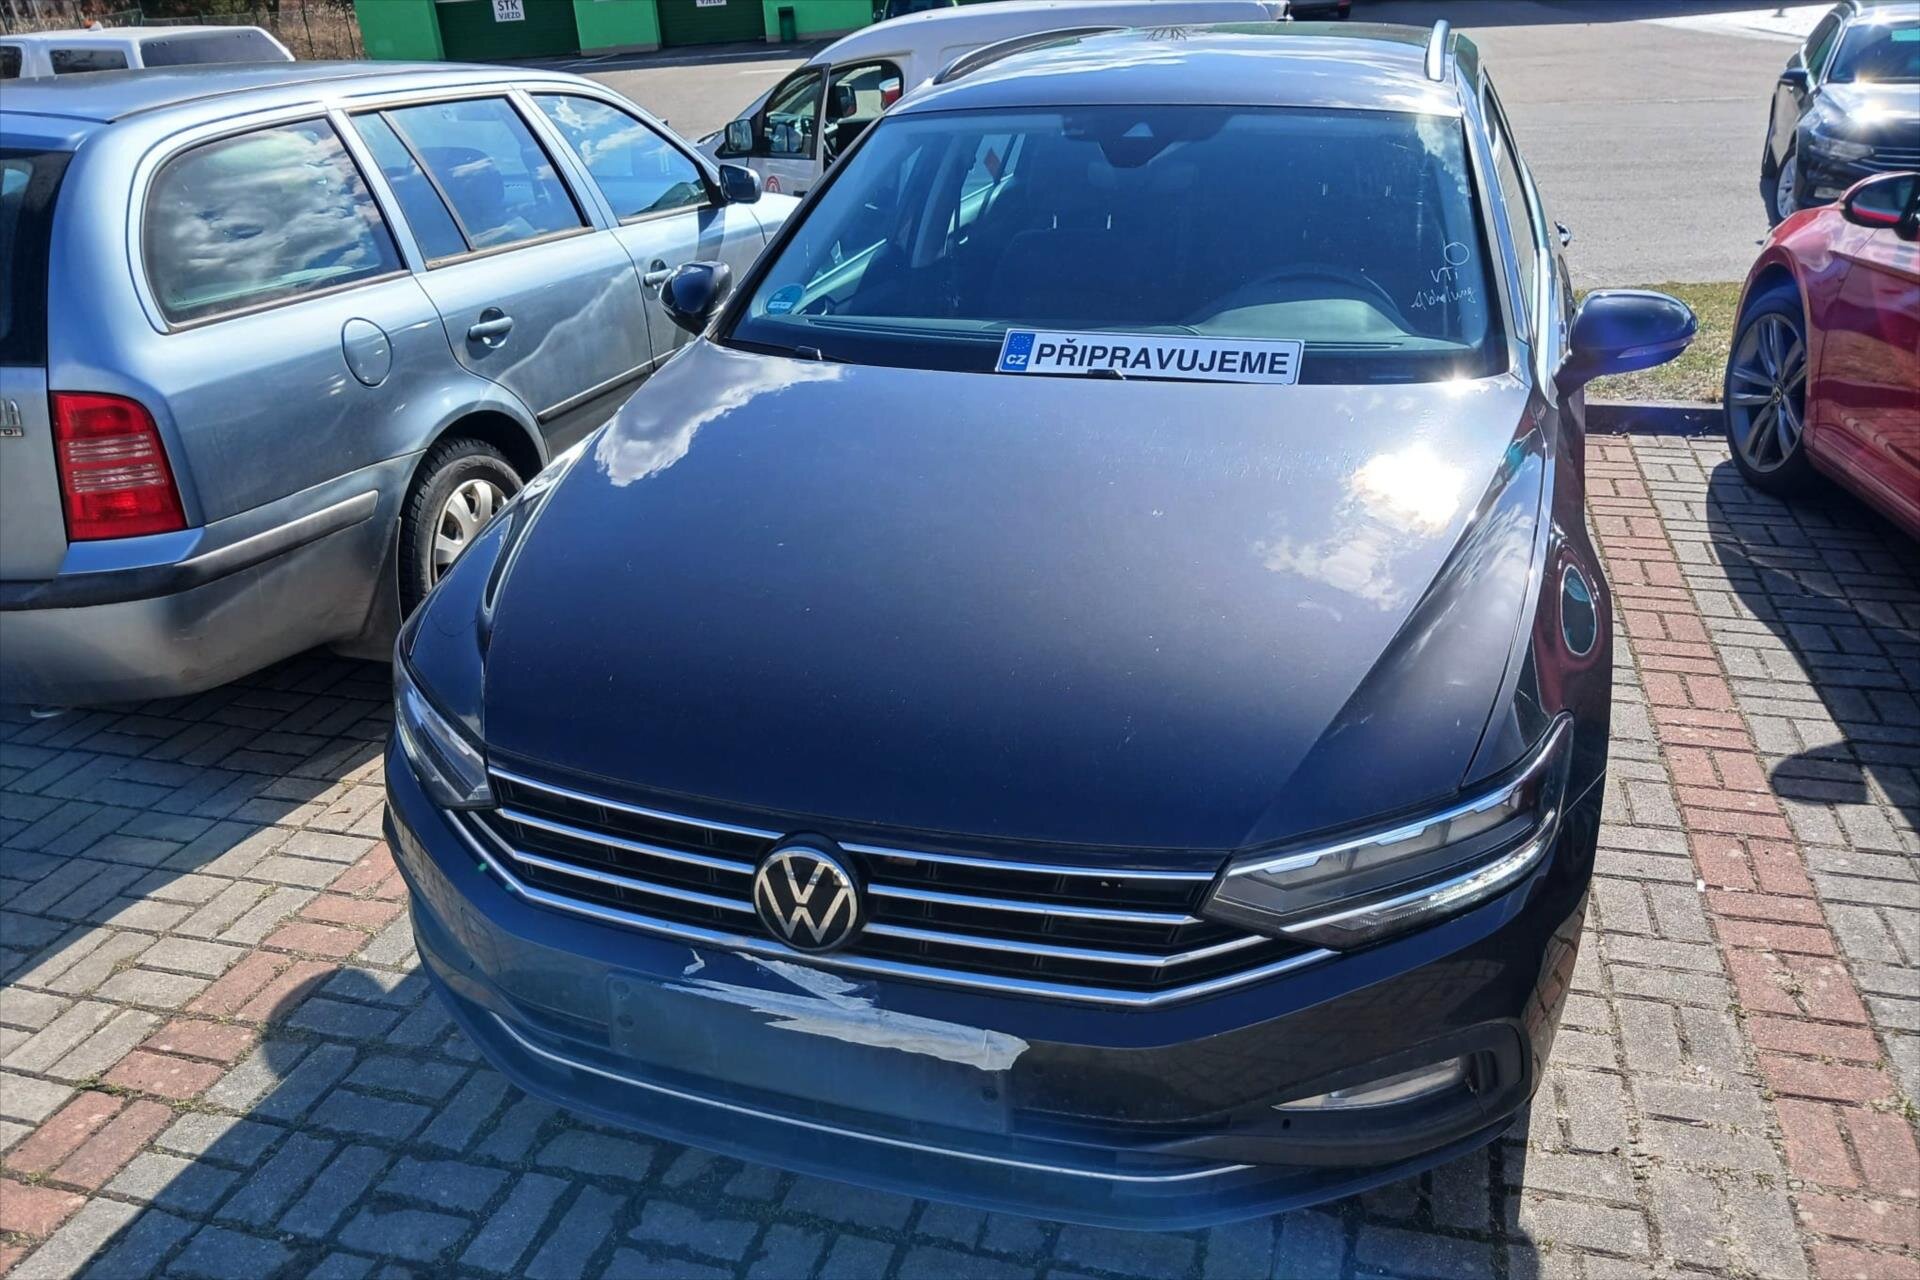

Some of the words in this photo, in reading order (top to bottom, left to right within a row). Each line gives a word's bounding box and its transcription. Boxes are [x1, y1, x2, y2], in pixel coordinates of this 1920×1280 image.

[498, 0, 518, 11] STK
[1006, 354, 1027, 365] CZ
[1035, 338, 1290, 375] PŘIPRAVUJEME
[757, 852, 855, 945] VW
